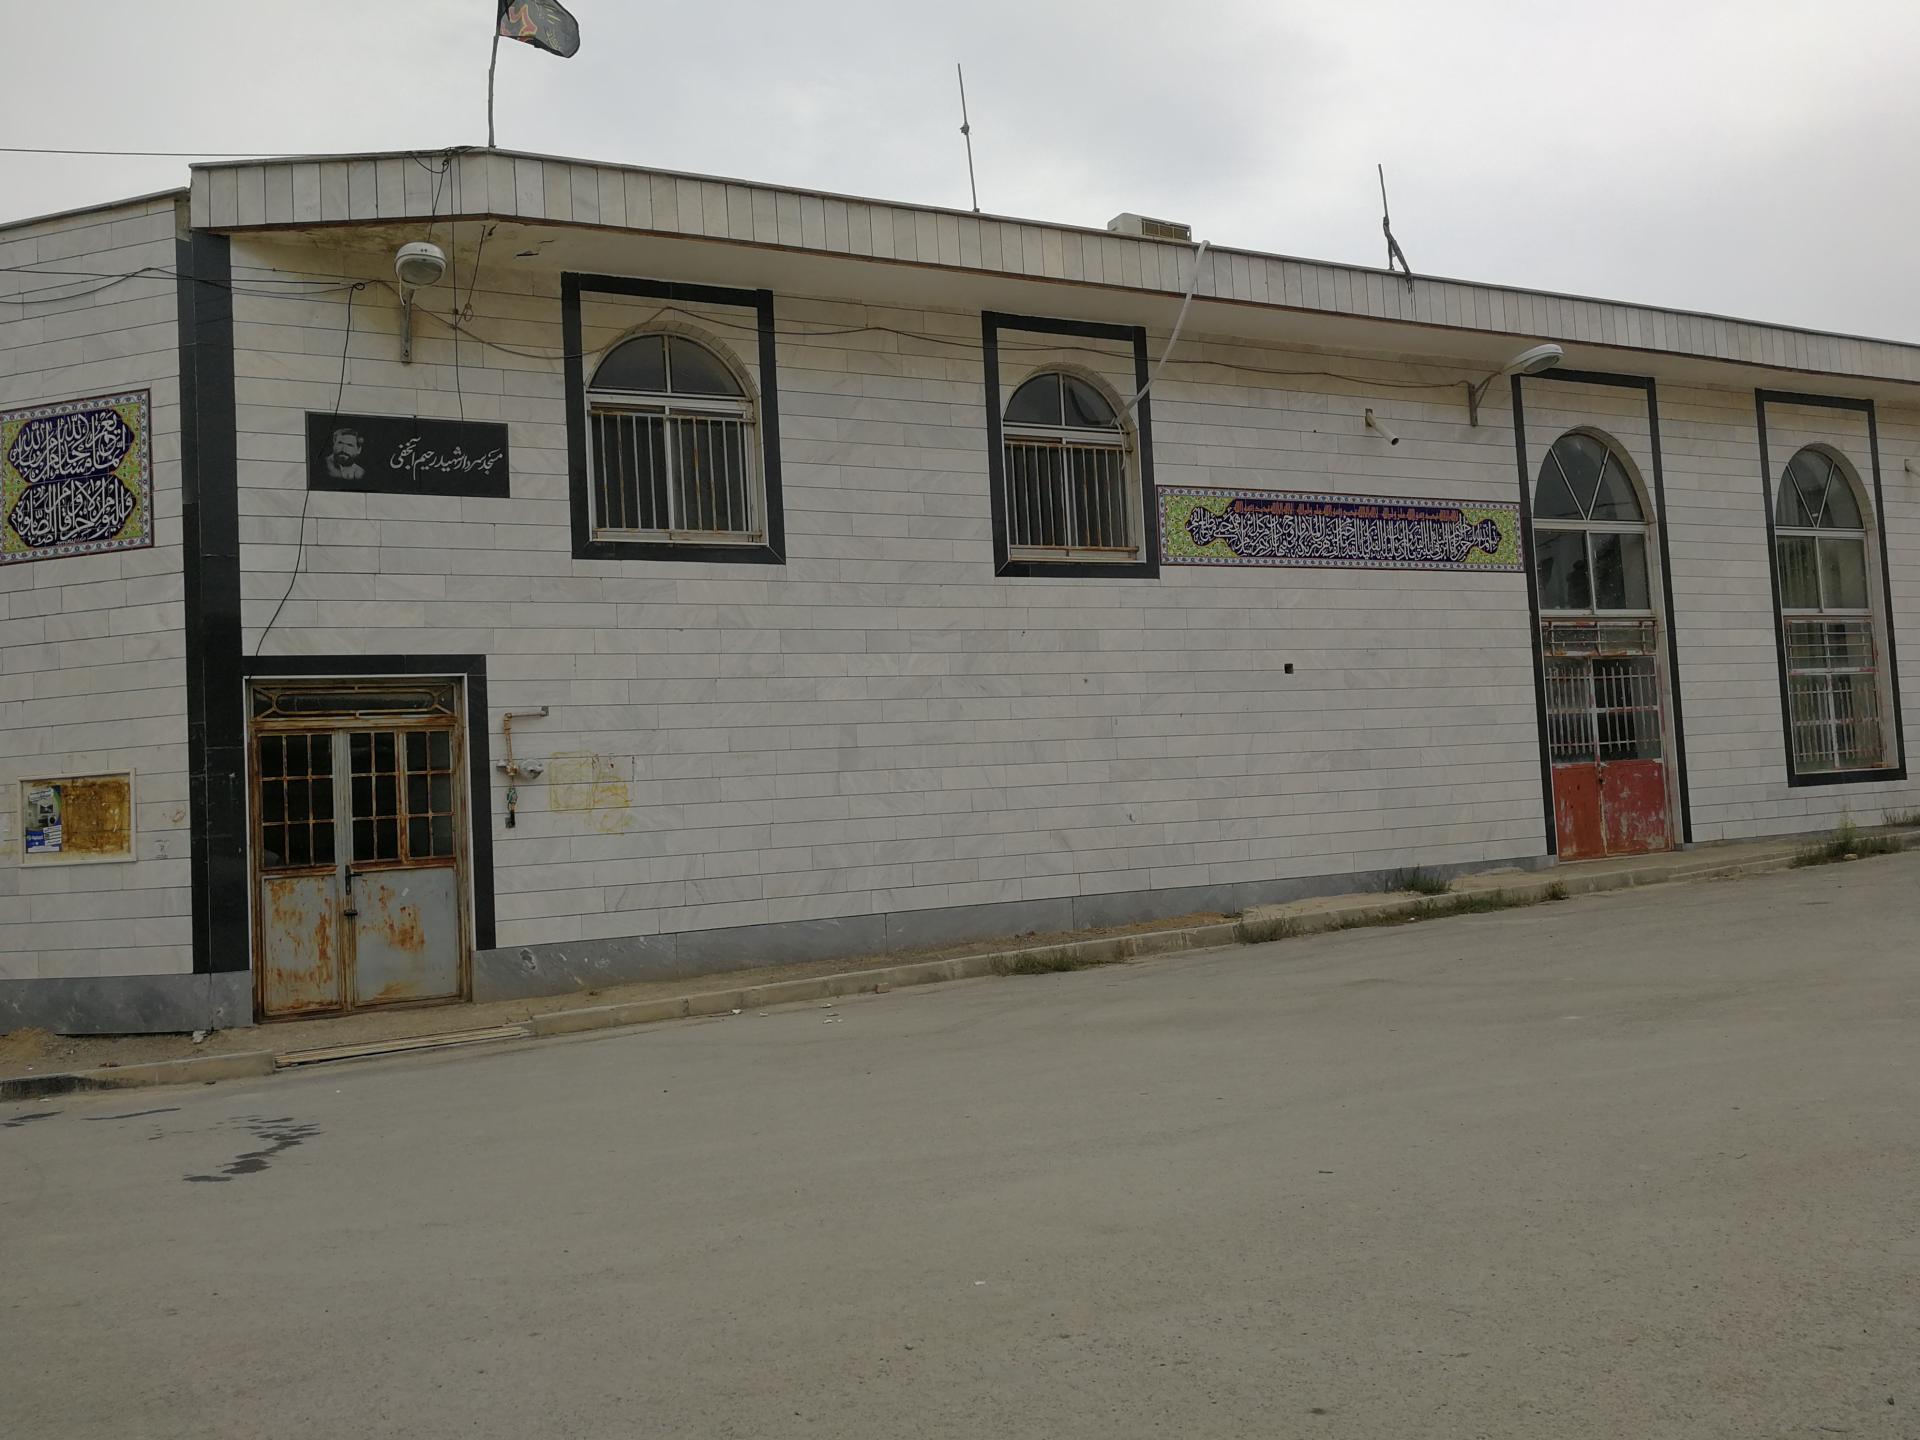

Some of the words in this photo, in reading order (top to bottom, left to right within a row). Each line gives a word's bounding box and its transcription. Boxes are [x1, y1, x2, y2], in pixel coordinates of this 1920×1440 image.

[413, 450, 438, 481] رحیم
[434, 446, 465, 472] شهید
[453, 453, 487, 473] سردار
[478, 448, 504, 475] مسجد
